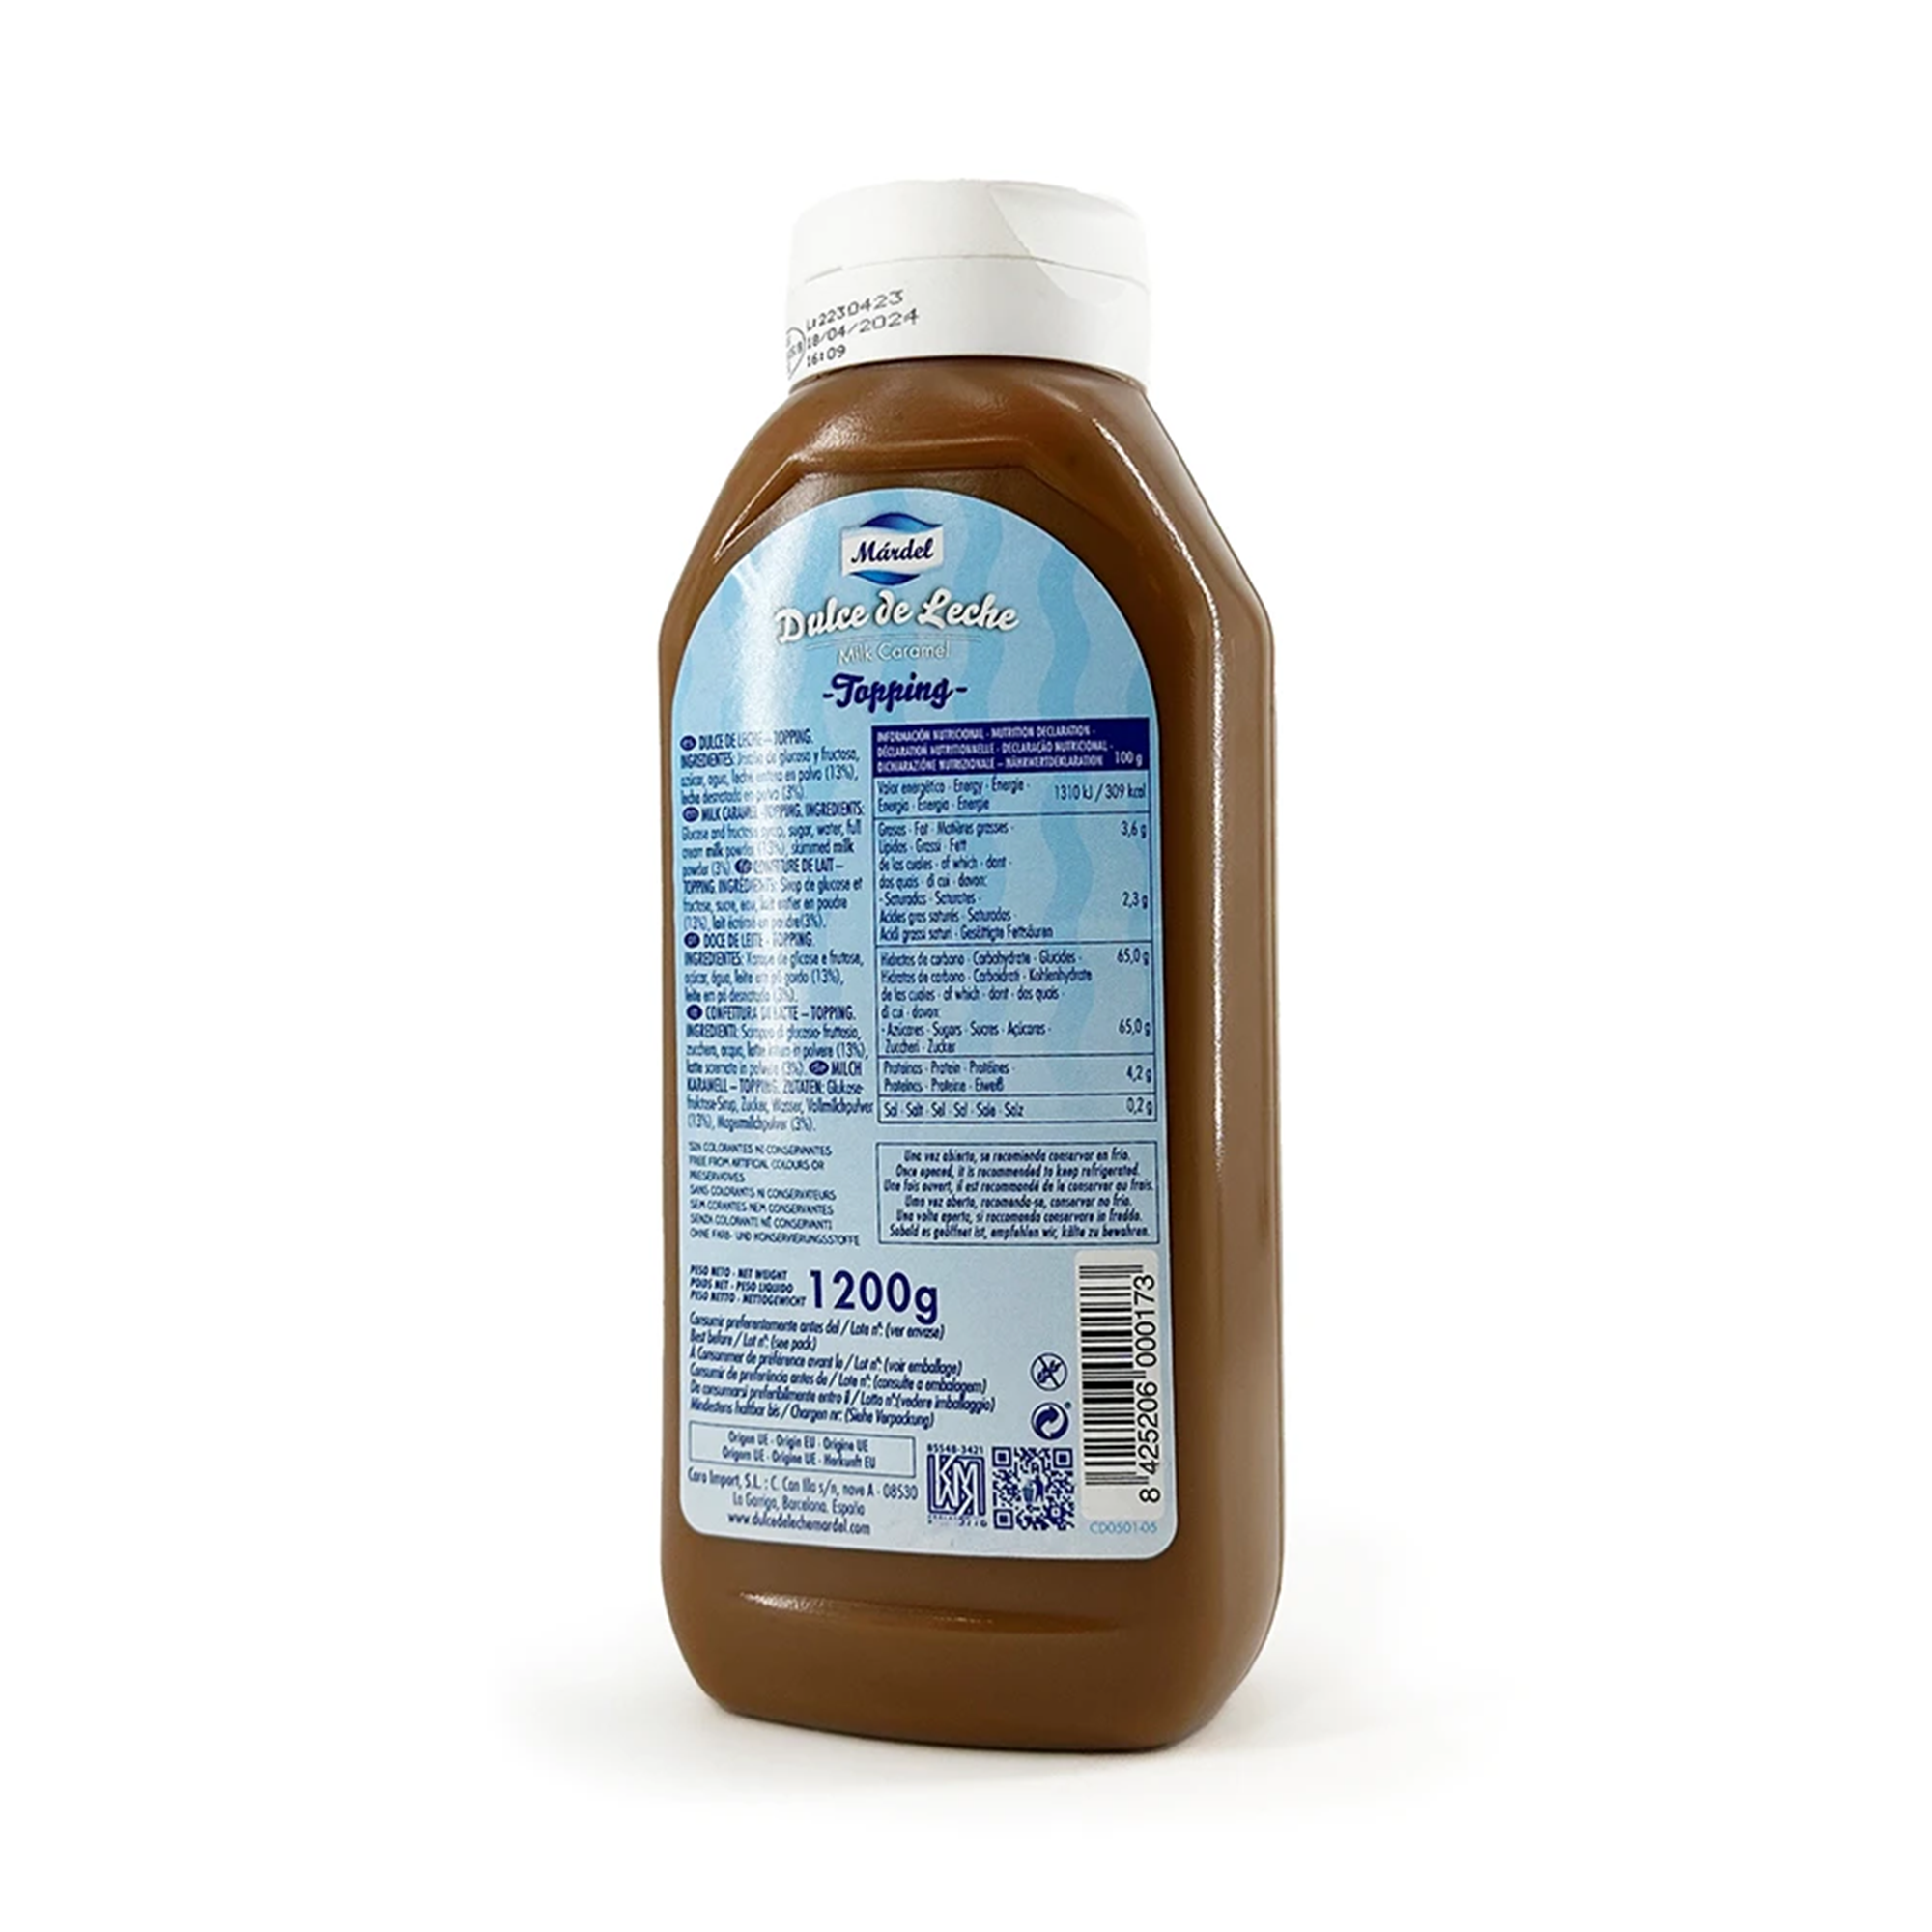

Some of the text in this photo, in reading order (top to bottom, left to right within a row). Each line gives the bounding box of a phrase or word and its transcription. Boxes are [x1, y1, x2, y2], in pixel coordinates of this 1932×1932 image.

[807, 308, 919, 349] 18/04/2024
[807, 345, 847, 367] 16:09
[851, 538, 934, 563] Márdel
[775, 588, 1019, 642] Dulce de Leche
[838, 640, 950, 665] Milk Caramel
[698, 733, 724, 751] DULCE
[877, 726, 1090, 742] INFORMACIÓN NUTRICIONAL NUTRITION DECLARATION
[1115, 753, 1133, 765] 100
[877, 781, 898, 794] Valor
[900, 780, 945, 797] energético
[952, 780, 982, 796] Energy
[1055, 783, 1146, 800] 1310 kJ 309 kcal
[788, 825, 814, 839] sugar,
[878, 821, 1009, 837] Grasas Fat Matières grasses
[1121, 822, 1137, 838] 3,6
[791, 839, 855, 855] skimmed milk
[818, 878, 863, 896] glucose et
[1122, 894, 1139, 909] 2,3
[1117, 950, 1140, 966] 65,0
[811, 969, 844, 985] (13%),
[811, 1006, 857, 1021] TOPPING.
[887, 1021, 1045, 1038] Azúcares Sugars Sucres Açúcares
[1118, 1020, 1142, 1037] 65,0
[803, 1044, 834, 1060] polvere
[837, 1043, 869, 1060] (13%),
[831, 1060, 862, 1076] MILCH
[1126, 1064, 1143, 1078] 4,2
[884, 1105, 898, 1118] Sal
[906, 1105, 923, 1118] Salt
[931, 1104, 946, 1117] Sel
[953, 1104, 968, 1117] Sal
[1004, 1104, 1024, 1117] Salz
[1126, 1099, 1143, 1115] 0,2
[895, 1165, 917, 1177] Once
[920, 1165, 952, 1179] opened,
[977, 1164, 1041, 1177] recommended
[1043, 1164, 1053, 1176] to
[1056, 1164, 1078, 1179] keep
[1081, 1164, 1140, 1179] refrigerated.
[690, 1266, 787, 1280] PESO NETO NET WEIGHT
[690, 1279, 794, 1294] POIDS NET PESO LIQUIDO
[690, 1292, 807, 1307] PESO NETTO NETTOGEWICHT
[810, 1269, 938, 1324] 1200g
[689, 1312, 724, 1327] Consumir
[799, 1318, 823, 1332] antes
[825, 1319, 839, 1333] del
[884, 1321, 904, 1340] (ver
[906, 1322, 945, 1342] envase)
[690, 1329, 817, 1353] Best before Lot (see pack)
[1133, 1274, 1161, 1503] 8 425206 000173
[727, 1432, 869, 1455] Origen UE Origin EU Origine UE
[722, 1446, 876, 1469] Origem UE Origine UE Herkunft EU
[732, 1492, 743, 1506] La
[745, 1492, 779, 1513] Garriga,
[832, 1500, 866, 1520] España
[727, 1510, 871, 1535] www.dulcedelechemardel.com
[1090, 1522, 1157, 1534] CD0501-05
